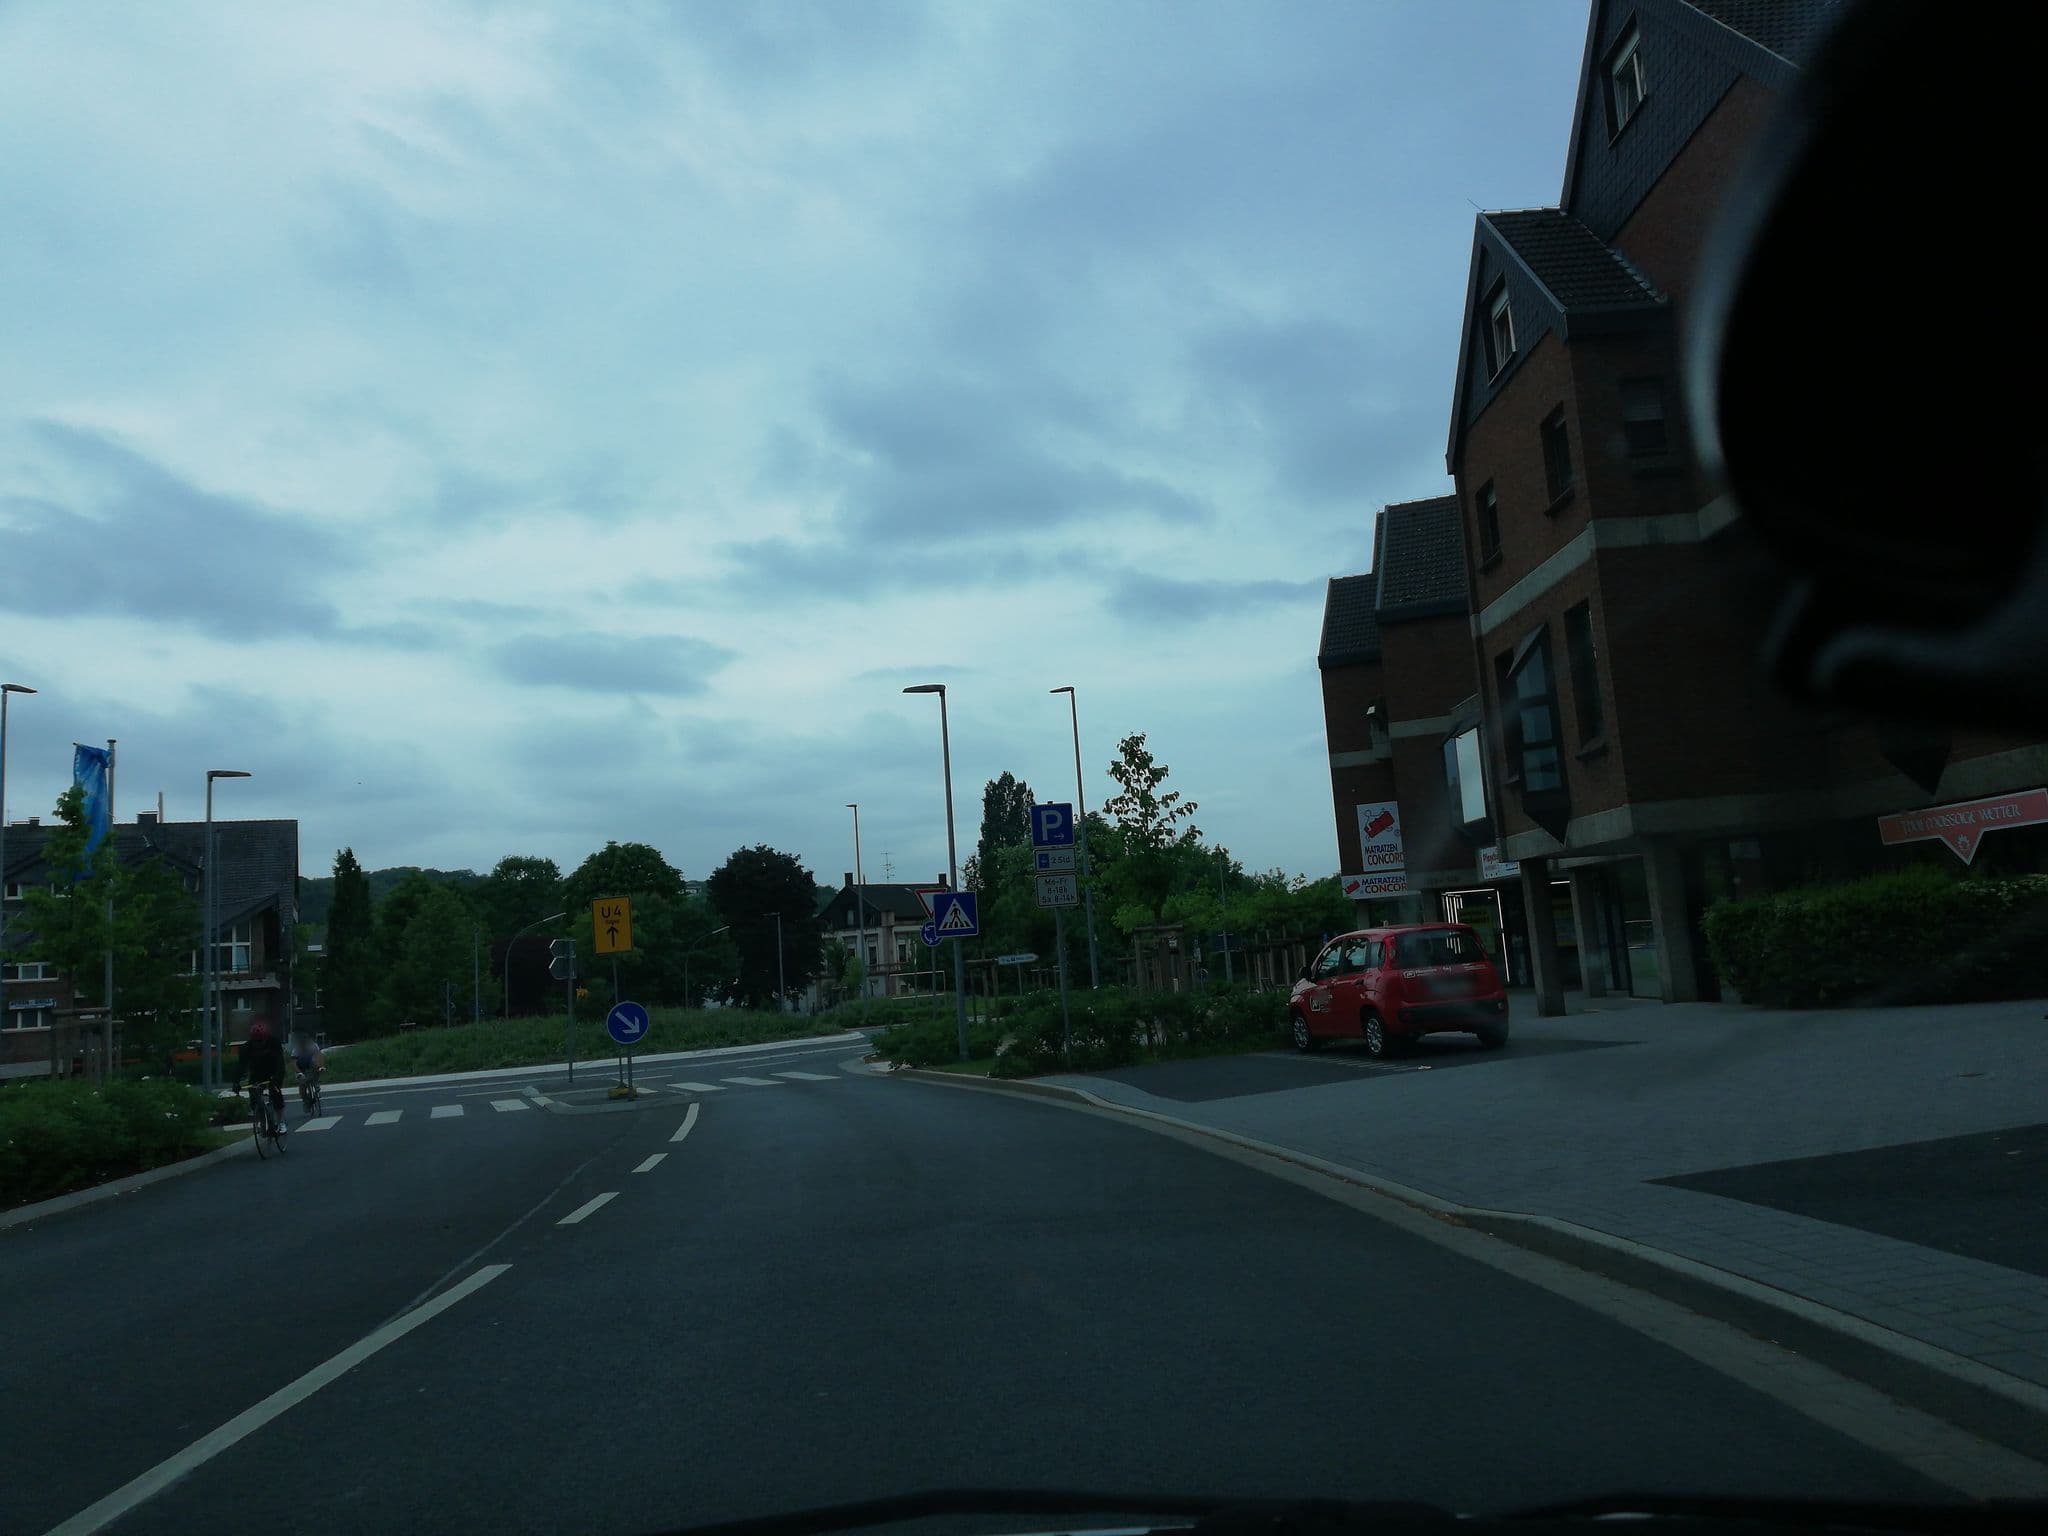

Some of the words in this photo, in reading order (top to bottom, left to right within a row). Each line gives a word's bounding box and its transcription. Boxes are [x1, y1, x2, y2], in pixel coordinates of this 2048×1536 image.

[1041, 810, 1063, 841] P
[1364, 843, 1398, 855] MATRATZEN
[1361, 876, 1405, 886] MATRATZEN
[1365, 883, 1408, 894] CONCOR
